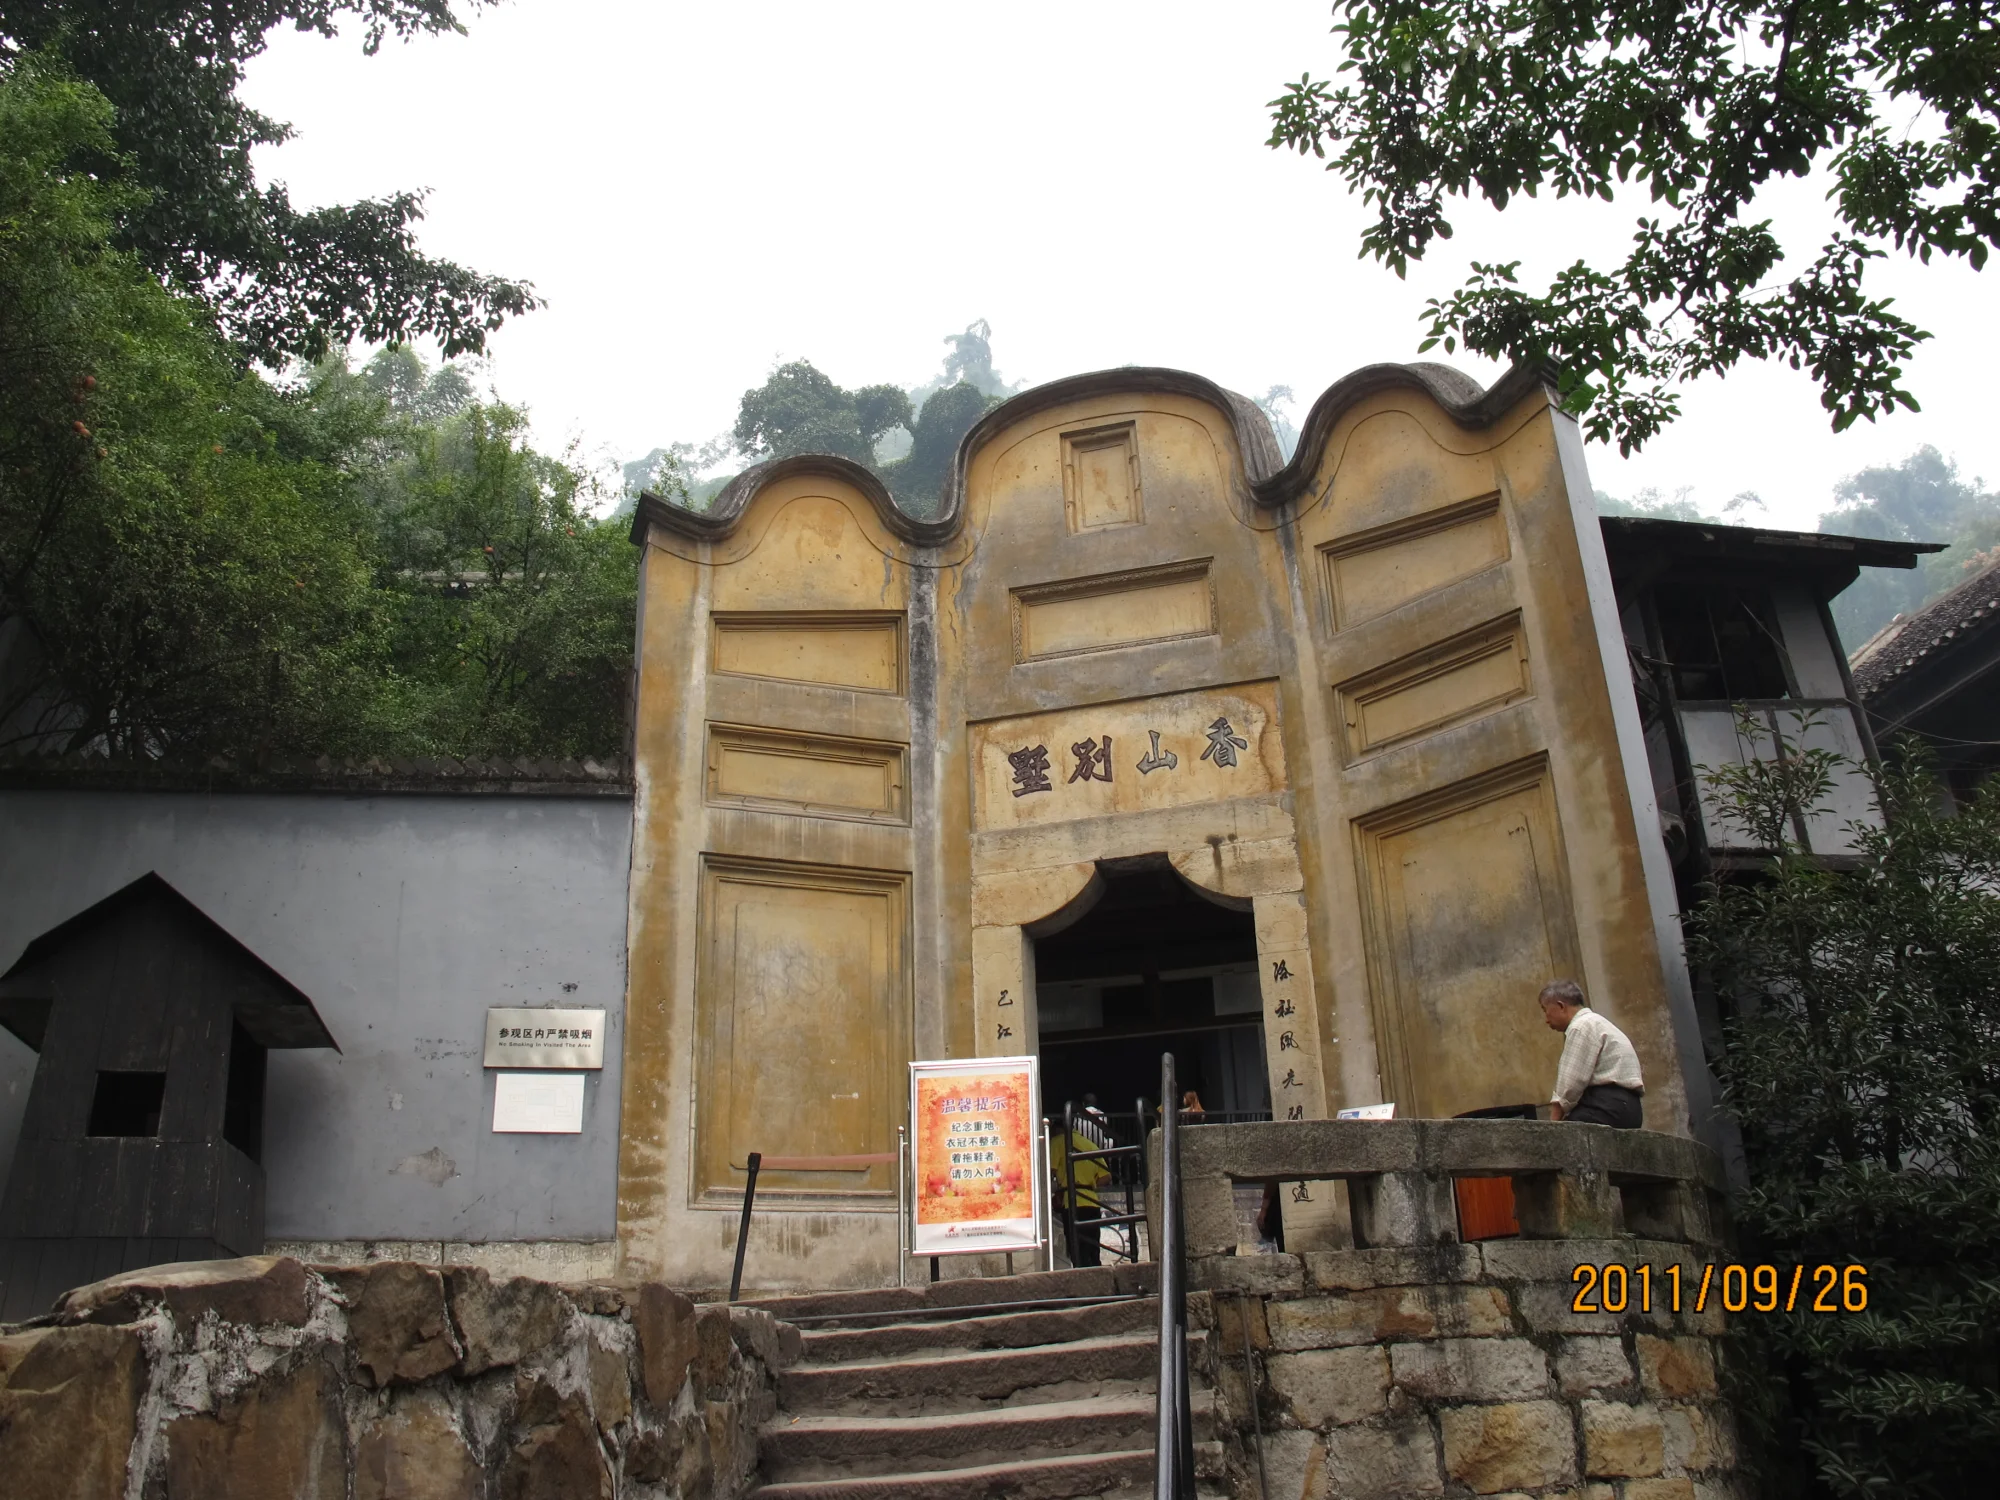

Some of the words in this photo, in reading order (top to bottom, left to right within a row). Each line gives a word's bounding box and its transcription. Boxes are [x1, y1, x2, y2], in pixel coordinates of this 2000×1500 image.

[498, 1028, 593, 1040] 参观区内严禁吸烟
[940, 1096, 1008, 1115] 温馨提示
